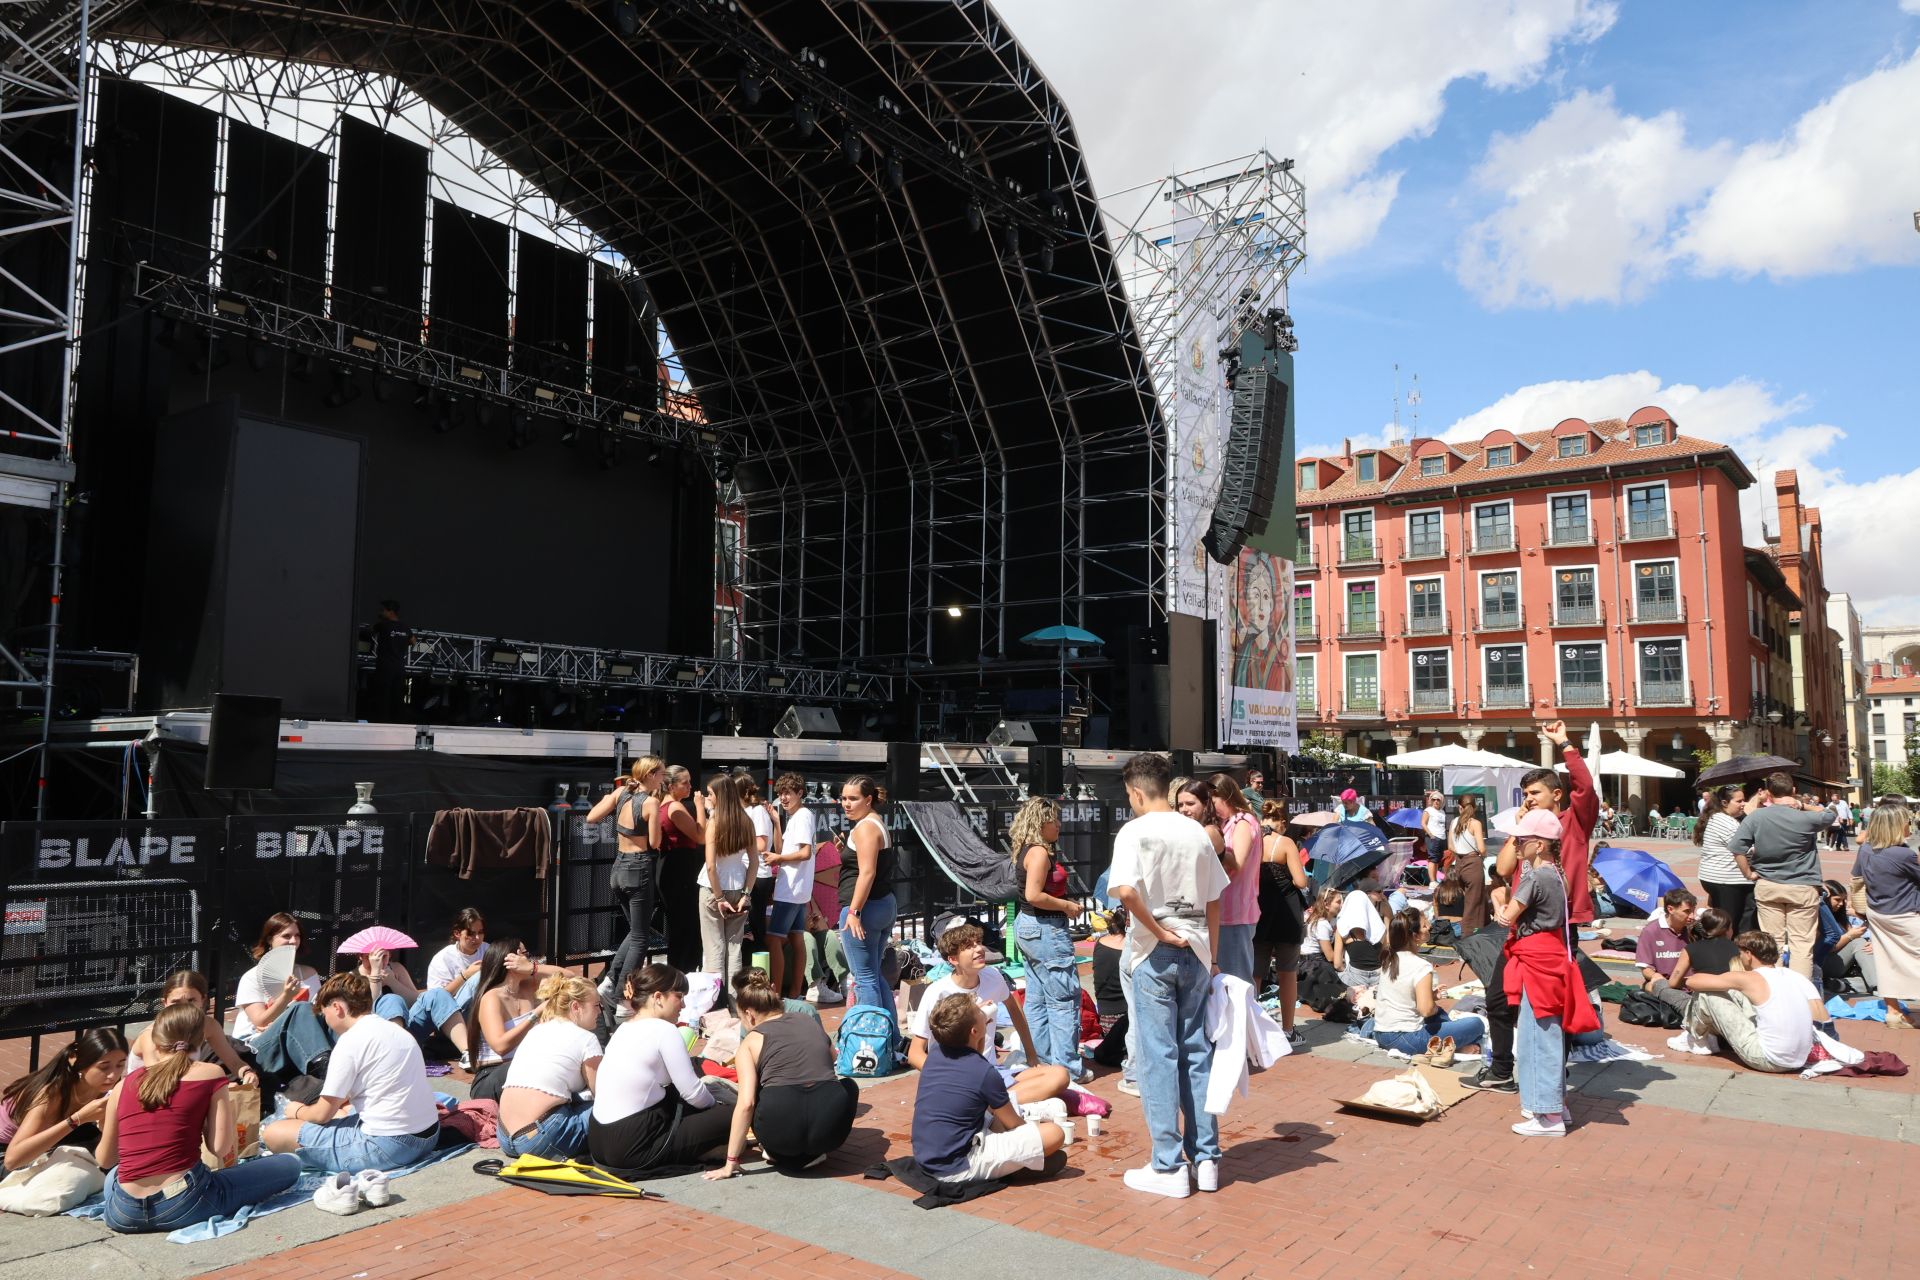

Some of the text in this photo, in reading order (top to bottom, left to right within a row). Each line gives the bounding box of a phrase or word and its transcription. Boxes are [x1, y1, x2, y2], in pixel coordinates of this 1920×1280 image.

[1061, 807, 1101, 822] BLAPE
[1288, 803, 1309, 814] BLAPE
[256, 827, 385, 858] BLAPE
[38, 836, 196, 869] BLAPE
[856, 1056, 876, 1069] 70
